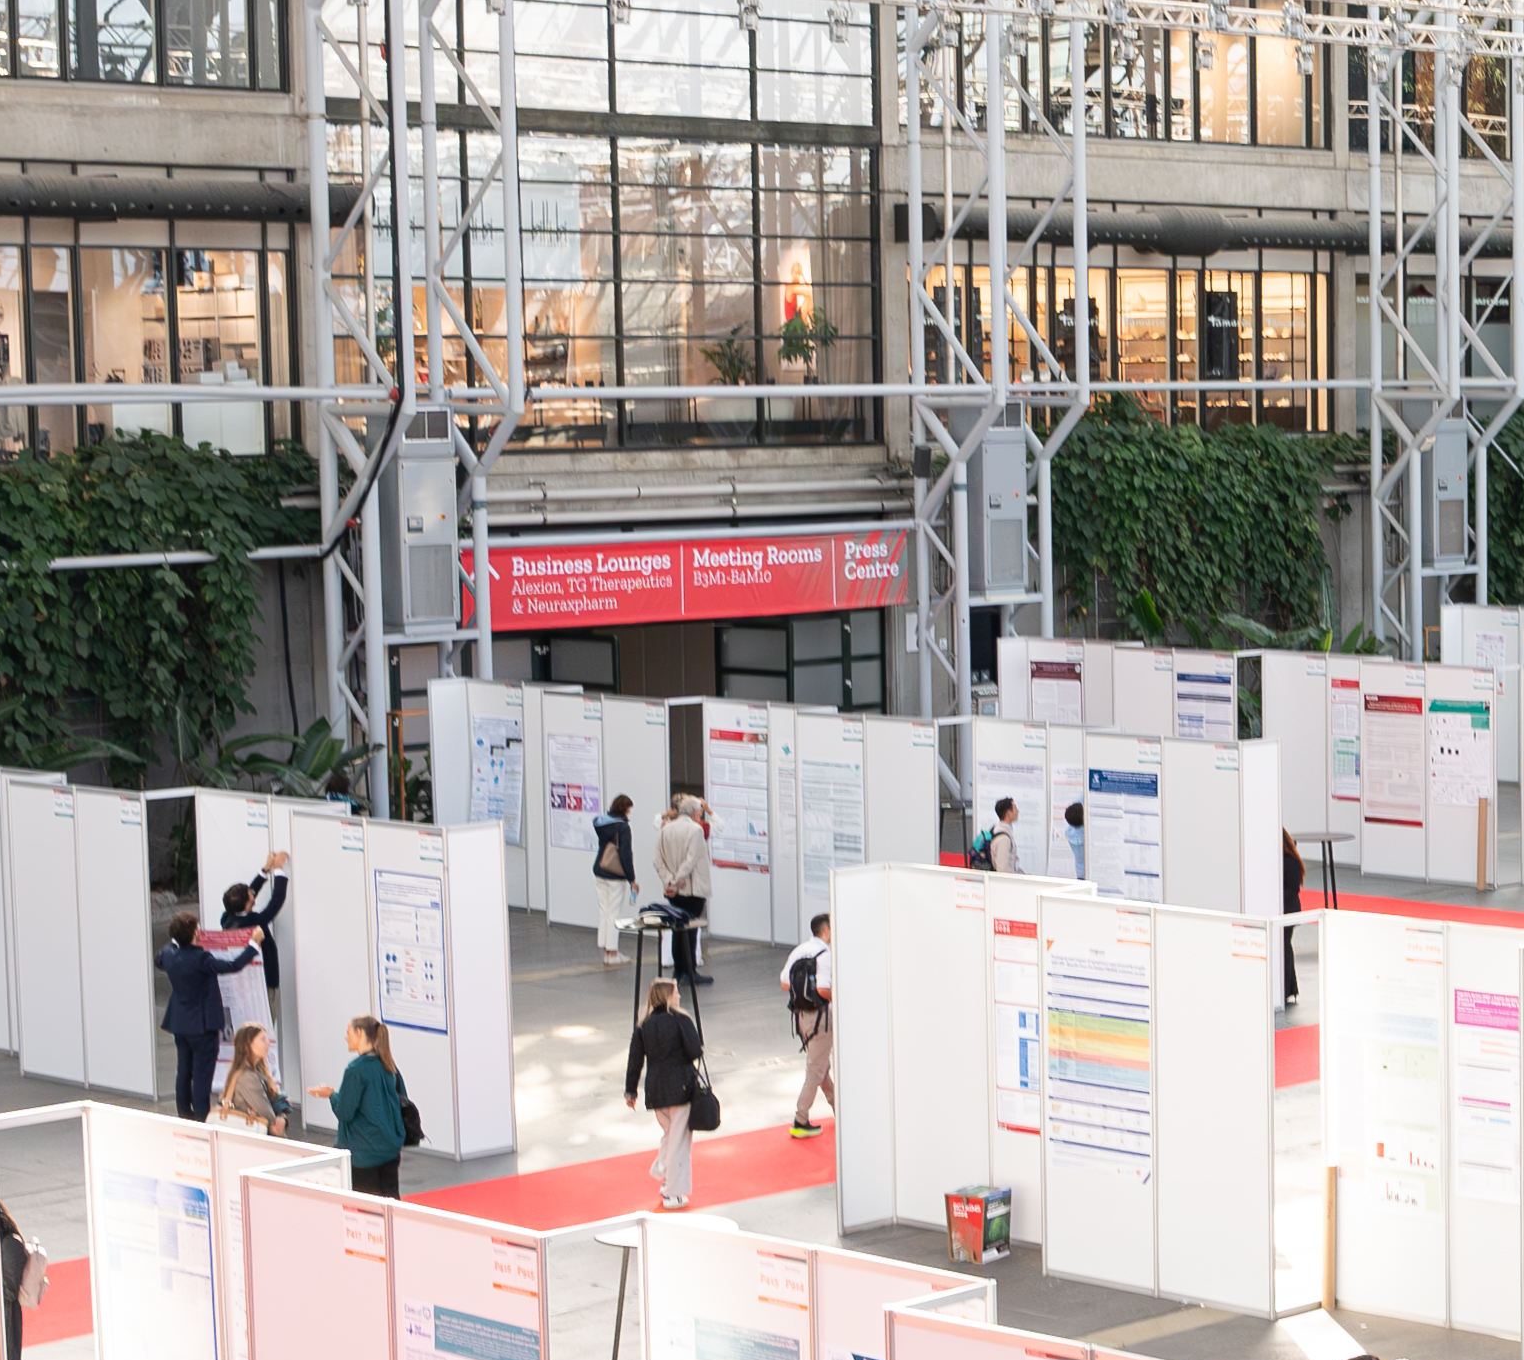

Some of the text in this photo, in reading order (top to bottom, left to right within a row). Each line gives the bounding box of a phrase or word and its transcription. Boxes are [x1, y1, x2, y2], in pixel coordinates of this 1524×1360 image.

[693, 546, 822, 570] Meeting Rooms
[844, 541, 888, 560] Press
[511, 553, 671, 577] Business Lounges
[844, 561, 899, 581] Centre
[512, 573, 673, 596] Alexion, TG Therapeutics
[512, 595, 618, 616] & Neuraxpharm
